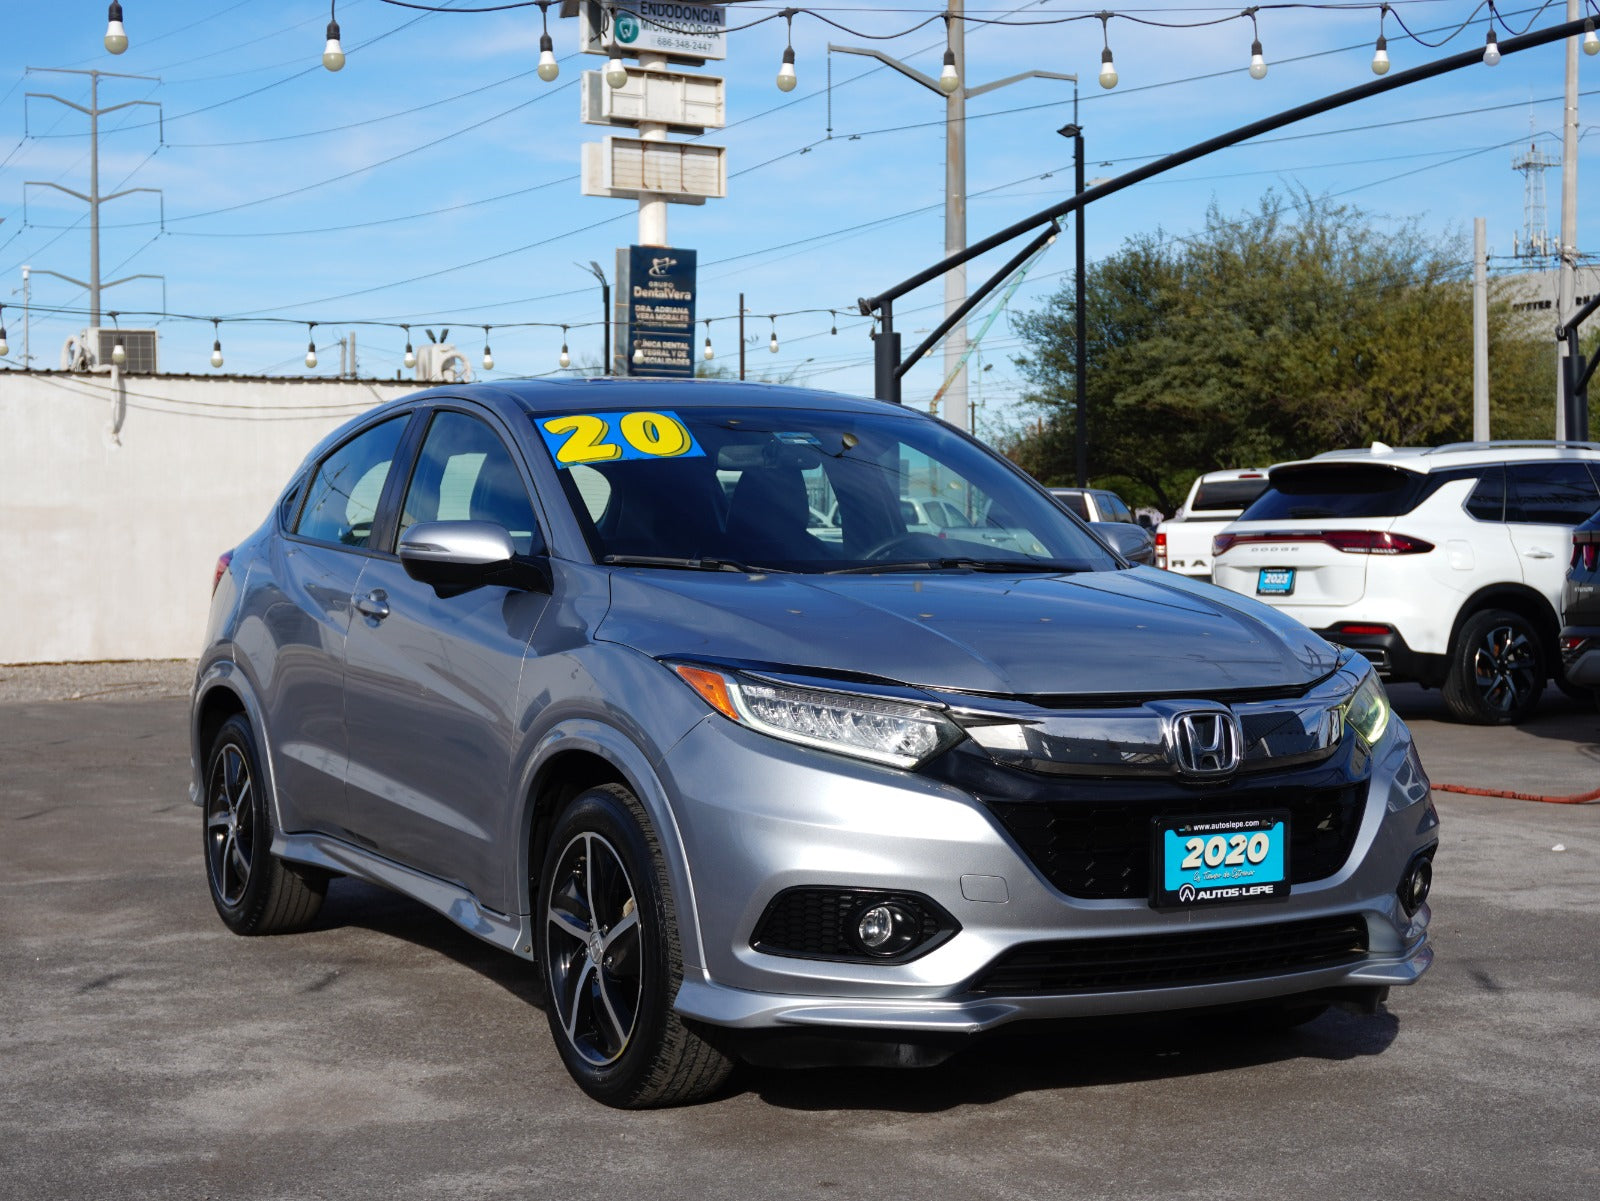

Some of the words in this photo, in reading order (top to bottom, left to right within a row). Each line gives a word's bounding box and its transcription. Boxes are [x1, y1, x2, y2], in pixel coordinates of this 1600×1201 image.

[640, 3, 721, 24] ENDODONCIA
[656, 37, 713, 51] 686-348-2447
[633, 286, 691, 300] DentalVera
[654, 305, 689, 315] ADRIANA
[635, 312, 655, 320] VERA
[655, 313, 689, 321] MORALES
[662, 341, 690, 350] DENTAL
[677, 350, 688, 358] DE
[543, 411, 692, 463] 20
[1264, 573, 1290, 584] 2023
[1193, 820, 1260, 831] www.autoslepe.com
[1181, 832, 1270, 869] 2020
